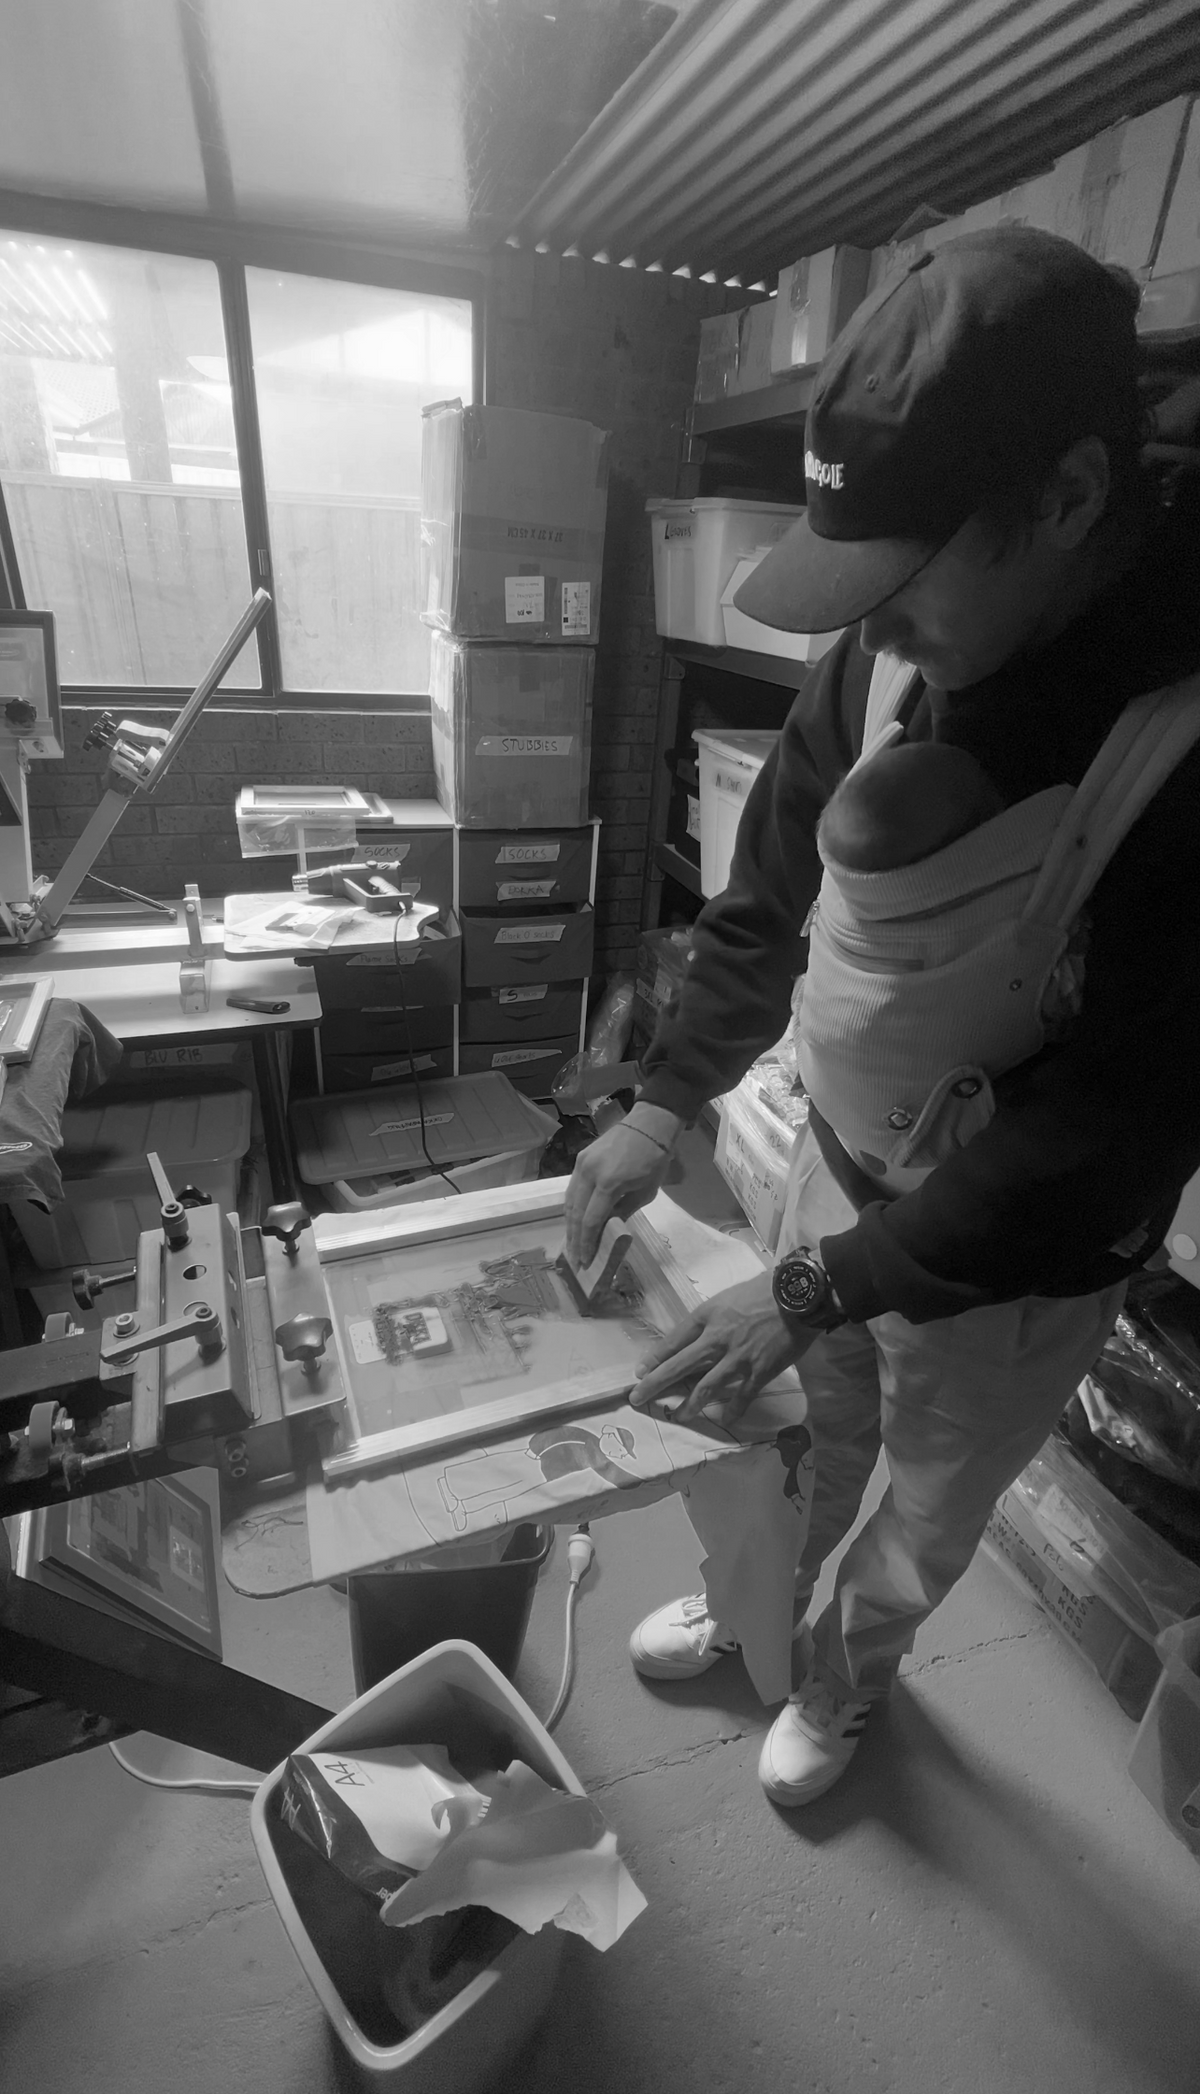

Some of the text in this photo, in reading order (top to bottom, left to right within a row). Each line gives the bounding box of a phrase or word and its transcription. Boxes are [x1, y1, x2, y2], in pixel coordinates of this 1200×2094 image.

[501, 738, 558, 753] STUBBIES
[364, 846, 401, 857] SOCKS
[508, 848, 547, 860] SOCKS
[507, 989, 518, 1001] S
[176, 1047, 203, 1063] RIB
[735, 1132, 745, 1154] XL
[769, 1133, 781, 1148] 22
[1043, 1543, 1065, 1572] Polo
[1057, 1595, 1084, 1630] KGS
[324, 1761, 365, 1786] A4
